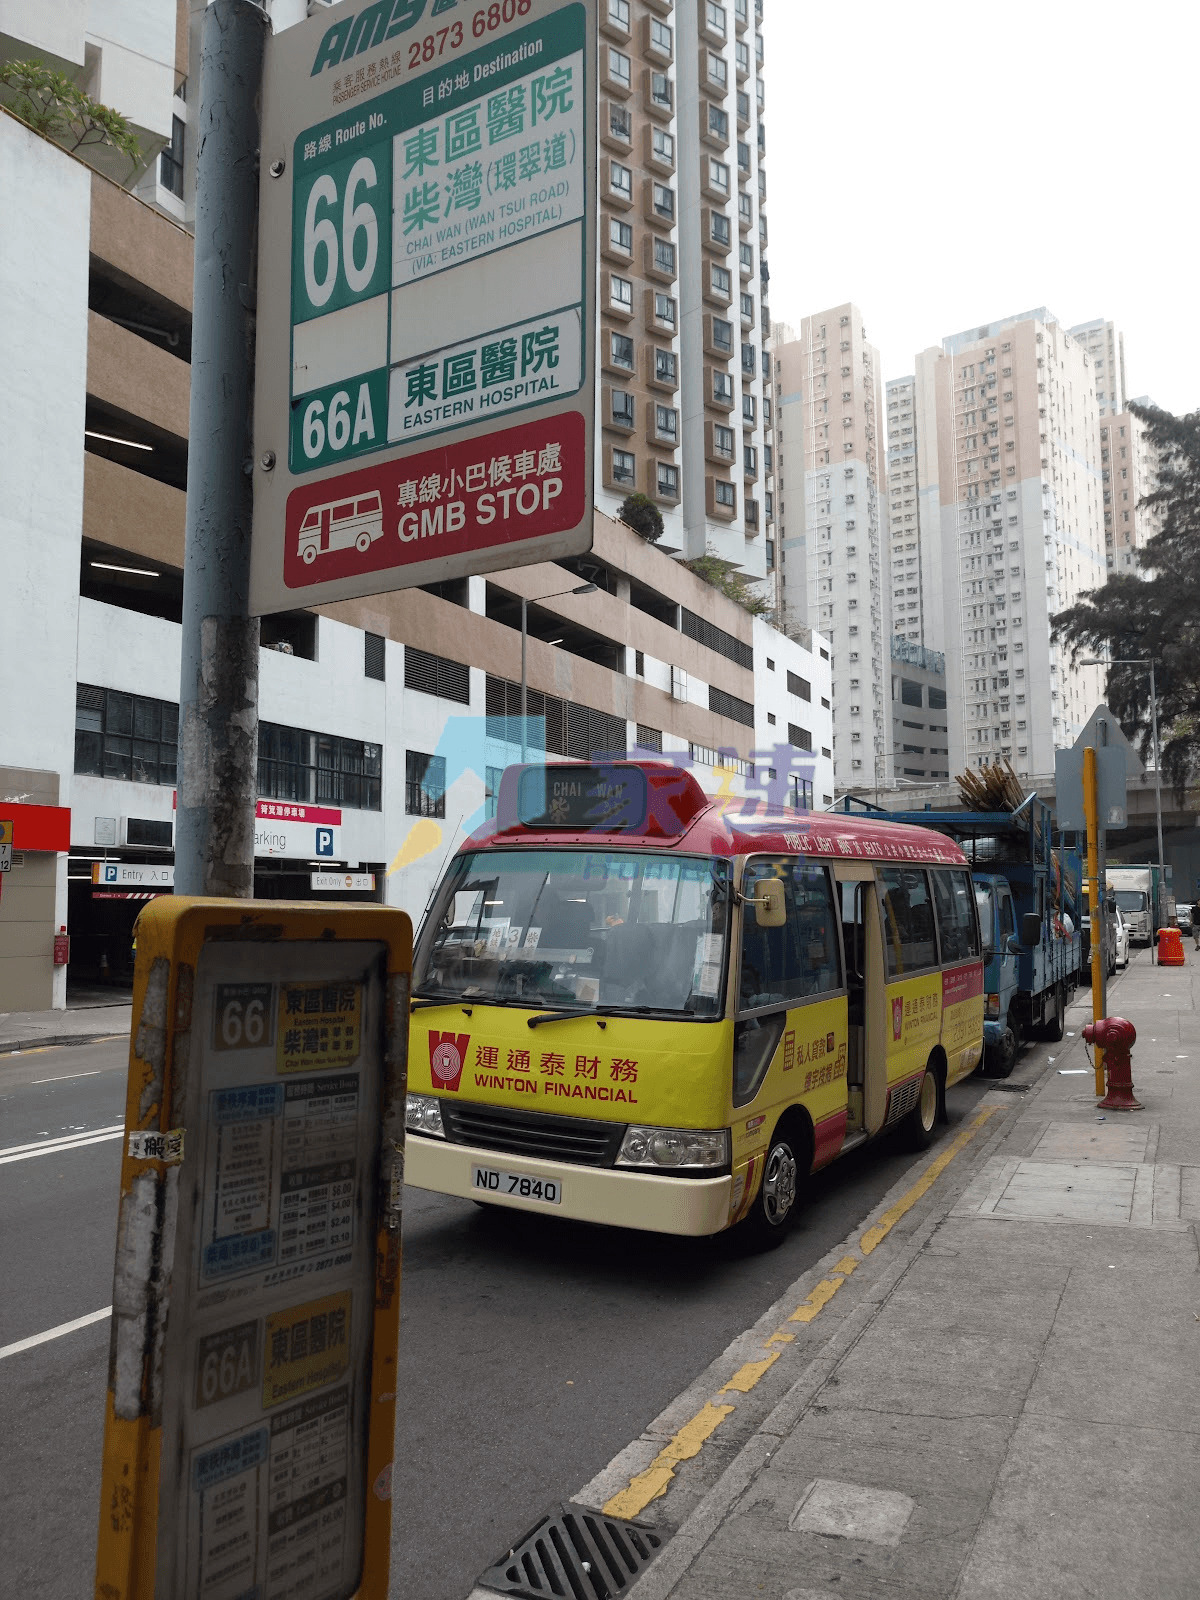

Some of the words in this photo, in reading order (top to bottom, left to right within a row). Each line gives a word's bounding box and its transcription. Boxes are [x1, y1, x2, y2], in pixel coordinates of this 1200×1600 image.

[408, 20, 464, 70] 2873
[472, 0, 533, 38] 6808
[361, 75, 381, 96] SERVICE
[380, 66, 401, 88] HOTLINE
[422, 72, 470, 107] 目的地
[473, 38, 543, 83] Destination
[303, 133, 332, 161] 路線
[335, 121, 366, 145] Route
[368, 113, 388, 133] No.
[402, 66, 573, 180] 東區醫院
[402, 128, 576, 237] 柴灣(環翠道)
[304, 157, 379, 307] 66
[406, 235, 432, 255] CHAI
[436, 224, 462, 246] WAN
[464, 209, 496, 236] (WAN
[499, 199, 526, 222] TSUI
[529, 181, 570, 211] ROAD)
[412, 253, 438, 275] (VIA:
[441, 232, 495, 262] EASTERN
[499, 207, 562, 240] HOSPITAL)
[404, 326, 560, 408] 東區醫院
[302, 383, 376, 459] 66A
[404, 399, 475, 430] EASTERN
[480, 375, 560, 409] HOSPITAL
[397, 442, 563, 509] 專線小巴候車處
[398, 501, 466, 544] GMB
[476, 477, 563, 525] STOP
[553, 782, 581, 796] CHAI
[254, 831, 286, 850] arking
[783, 833, 812, 852] PUBLIC
[813, 836, 835, 853] LIGHT
[837, 839, 853, 854] BUS
[863, 841, 884, 856] SEATS
[122, 869, 144, 882] Entry
[151, 871, 169, 881] 入口
[316, 876, 328, 886] Exit
[329, 876, 342, 887] Only
[222, 999, 264, 1046] 66
[286, 984, 355, 1015] 東區醫院
[294, 1017, 317, 1027] Eastern
[319, 1015, 346, 1026] Hospital
[474, 1073, 538, 1094] WINTON
[544, 1082, 638, 1104] FINANCIAL
[475, 1045, 640, 1084] 運通泰財務
[476, 1169, 500, 1190] ND
[508, 1175, 557, 1201] 7840
[329, 1231, 350, 1245] $3.10
[330, 1215, 350, 1228] $2.40
[270, 1307, 346, 1370] 東區醫院
[202, 1340, 252, 1401] 66A
